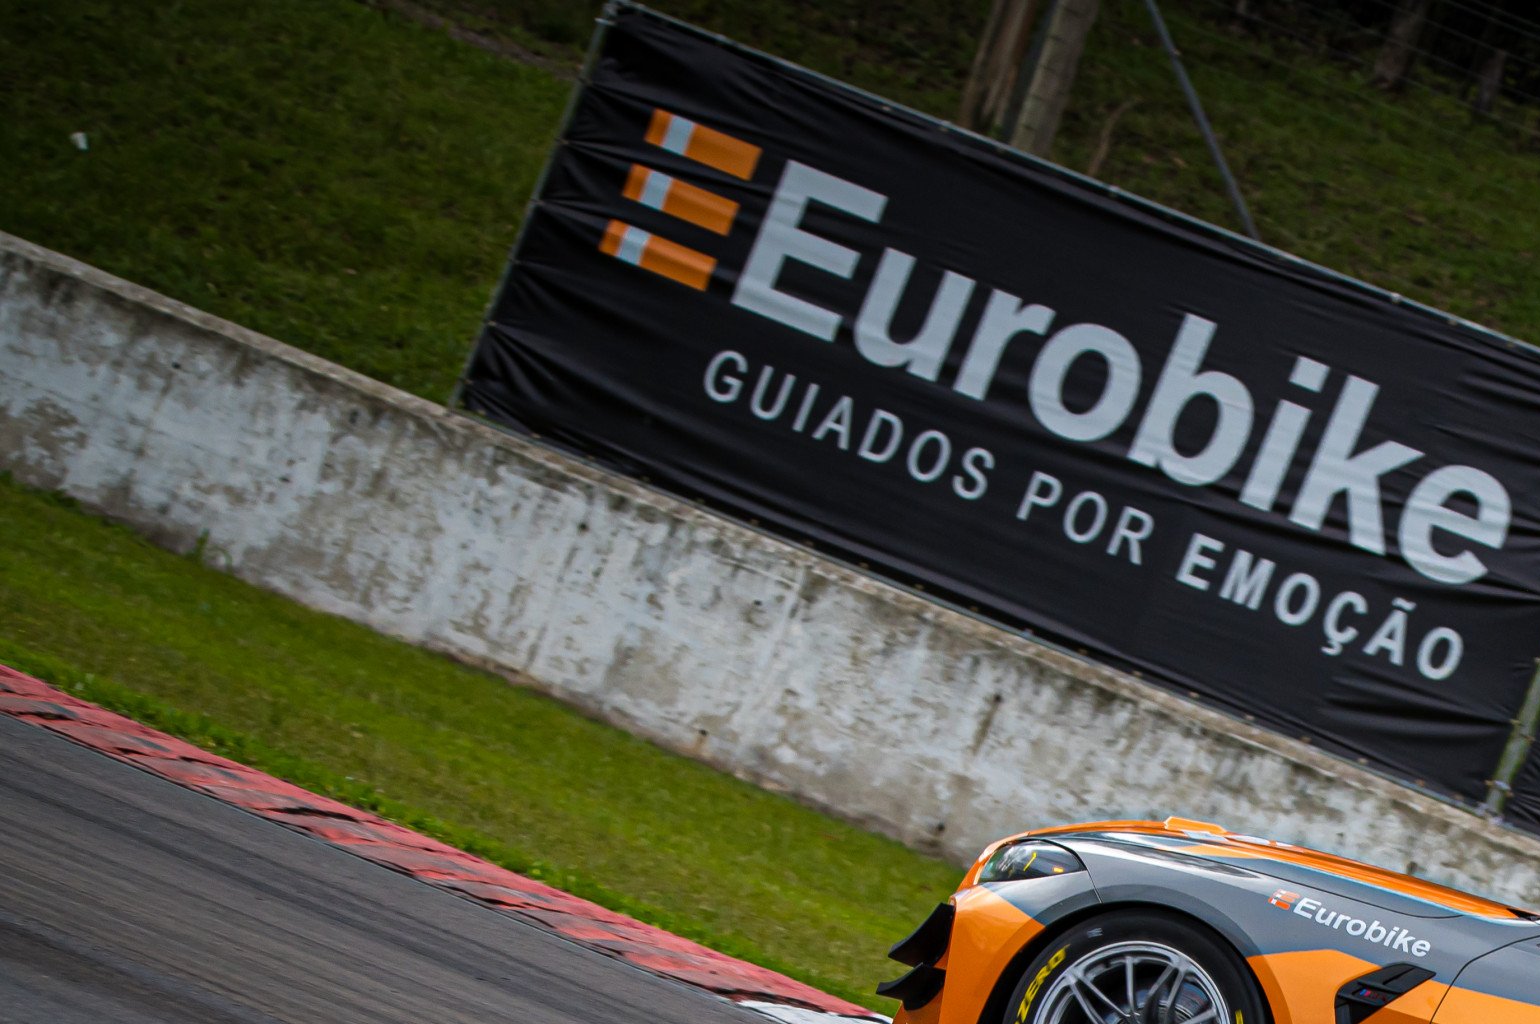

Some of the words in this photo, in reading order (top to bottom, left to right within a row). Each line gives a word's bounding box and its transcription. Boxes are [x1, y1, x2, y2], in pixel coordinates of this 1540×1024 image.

[706, 350, 994, 499] GUIADOS
[1018, 472, 1153, 565] POR
[1177, 534, 1463, 680] EMOÇÃO
[733, 160, 1511, 585] Eurobike
[1294, 897, 1431, 958] Eurobike
